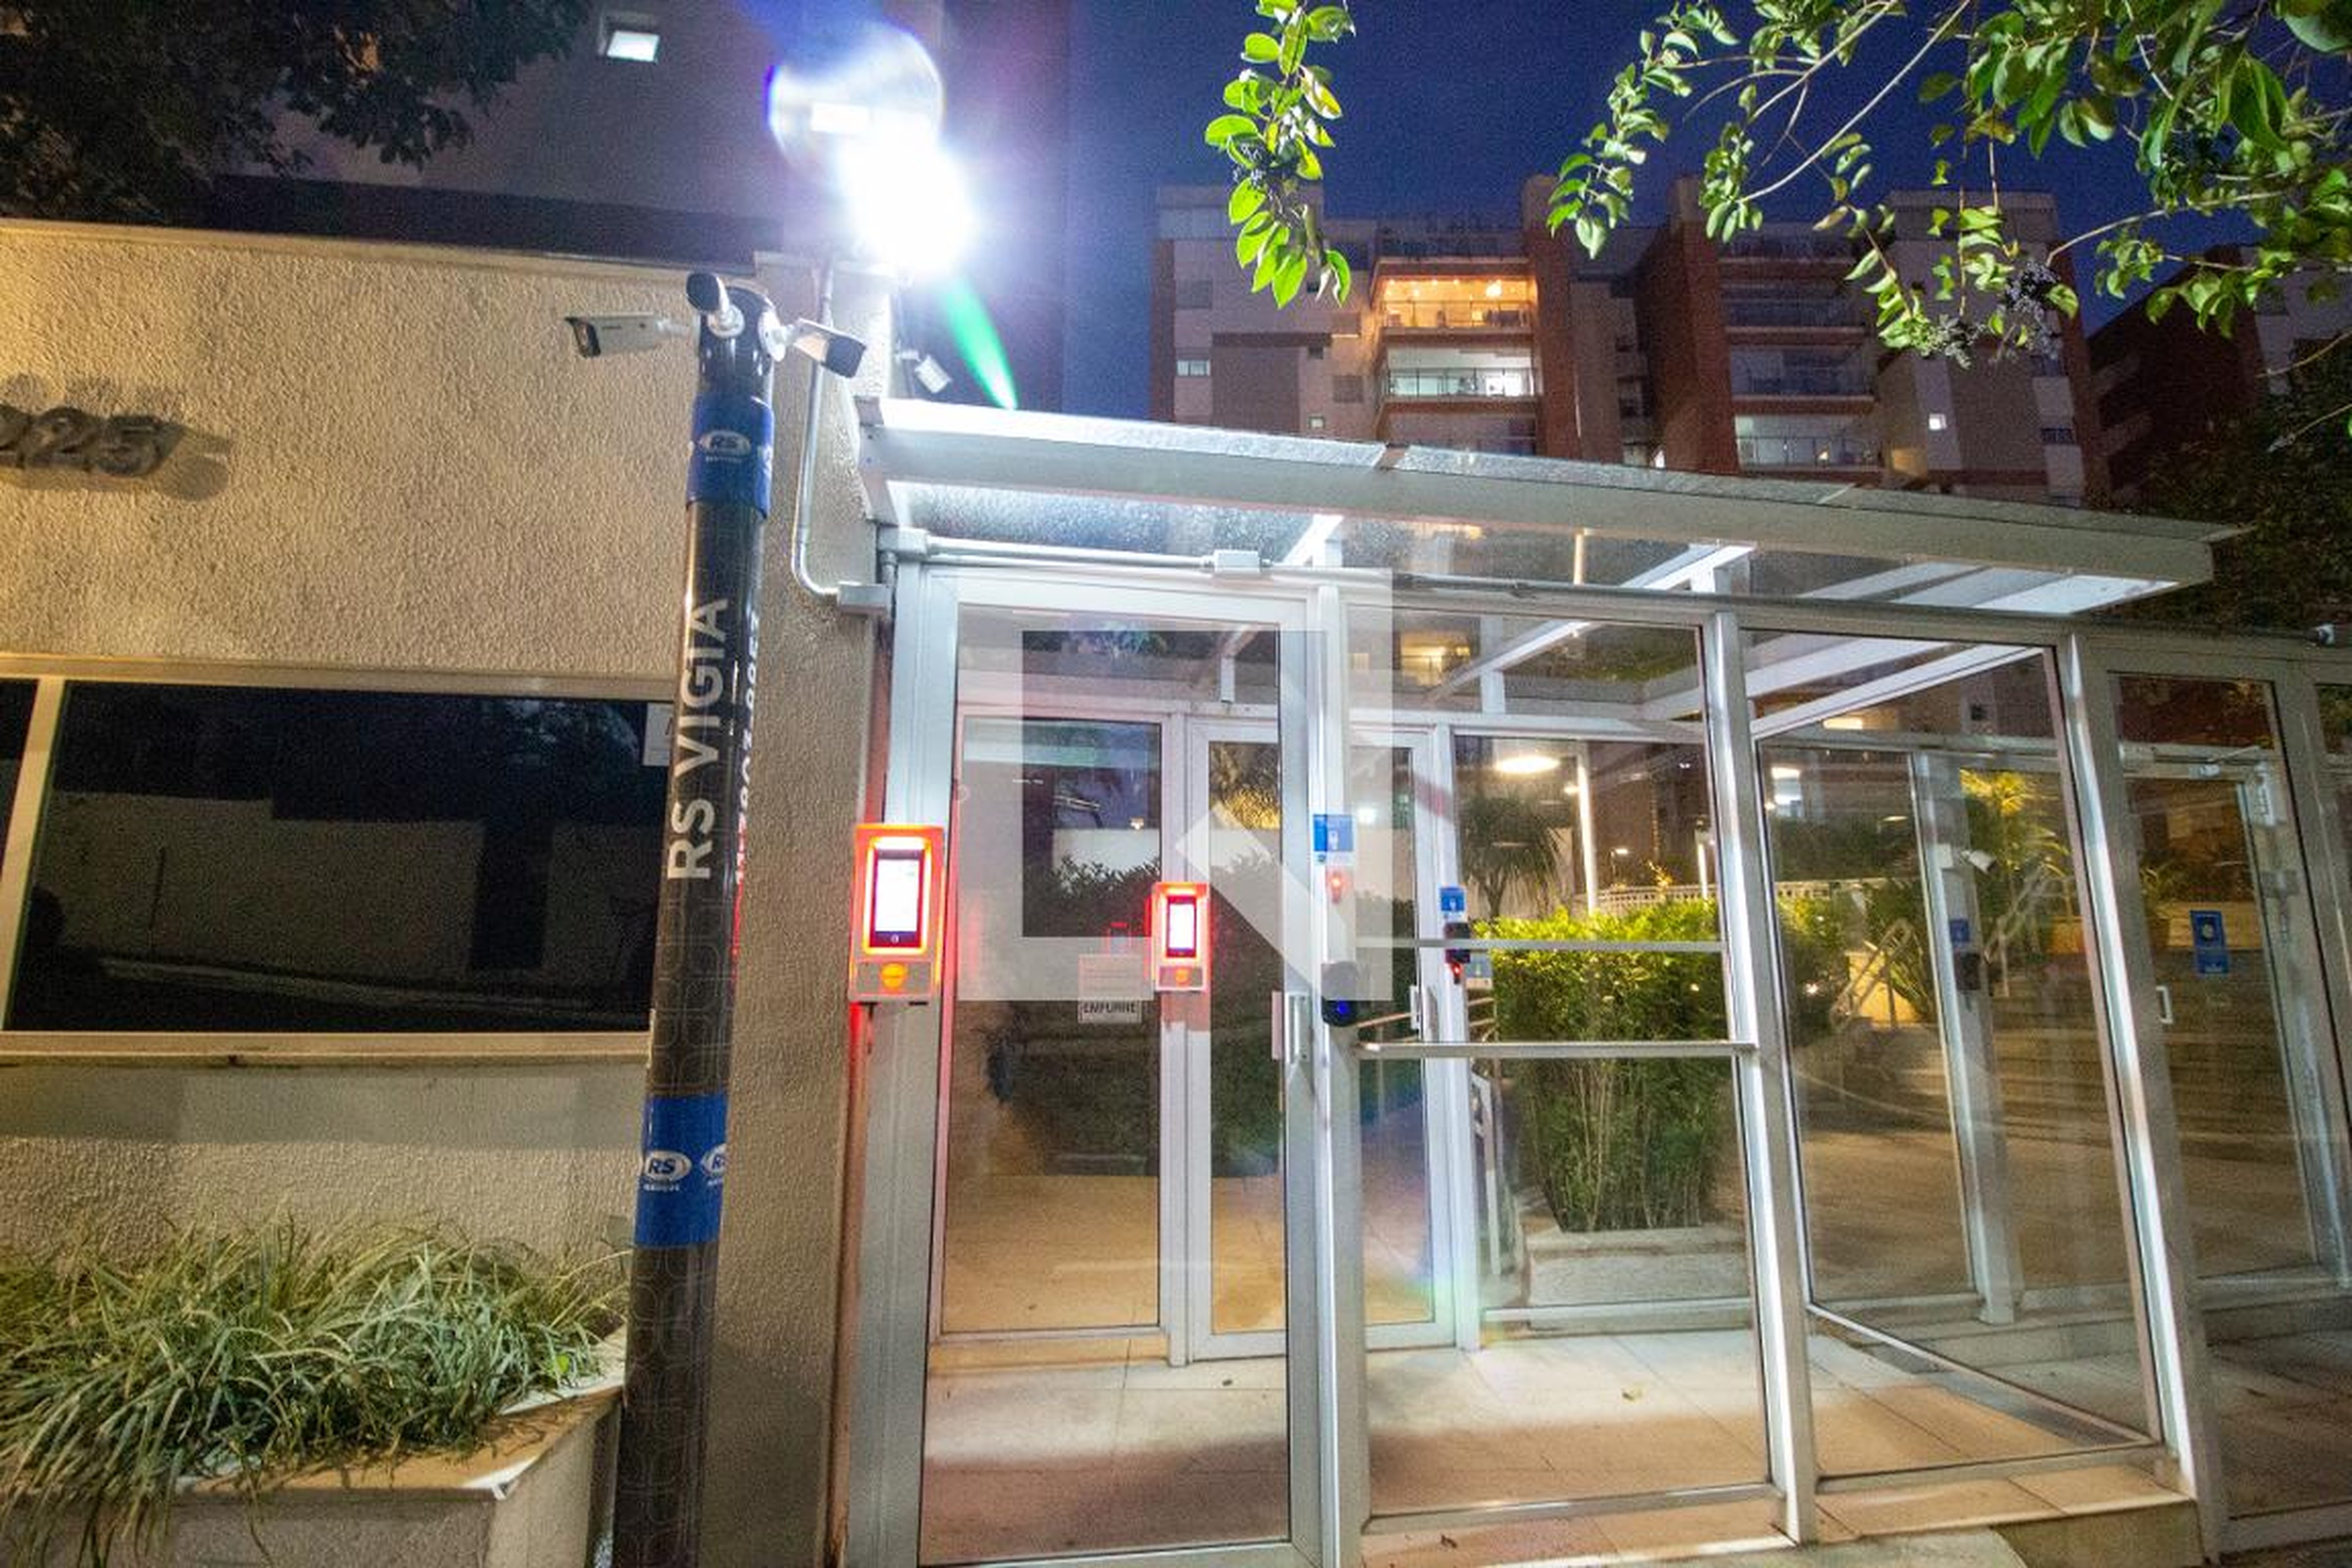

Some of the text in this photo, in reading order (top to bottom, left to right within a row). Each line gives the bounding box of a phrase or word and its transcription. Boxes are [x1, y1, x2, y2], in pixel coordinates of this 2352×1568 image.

[668, 598, 729, 880] RS VIGIA
[648, 1158, 676, 1174] RS
